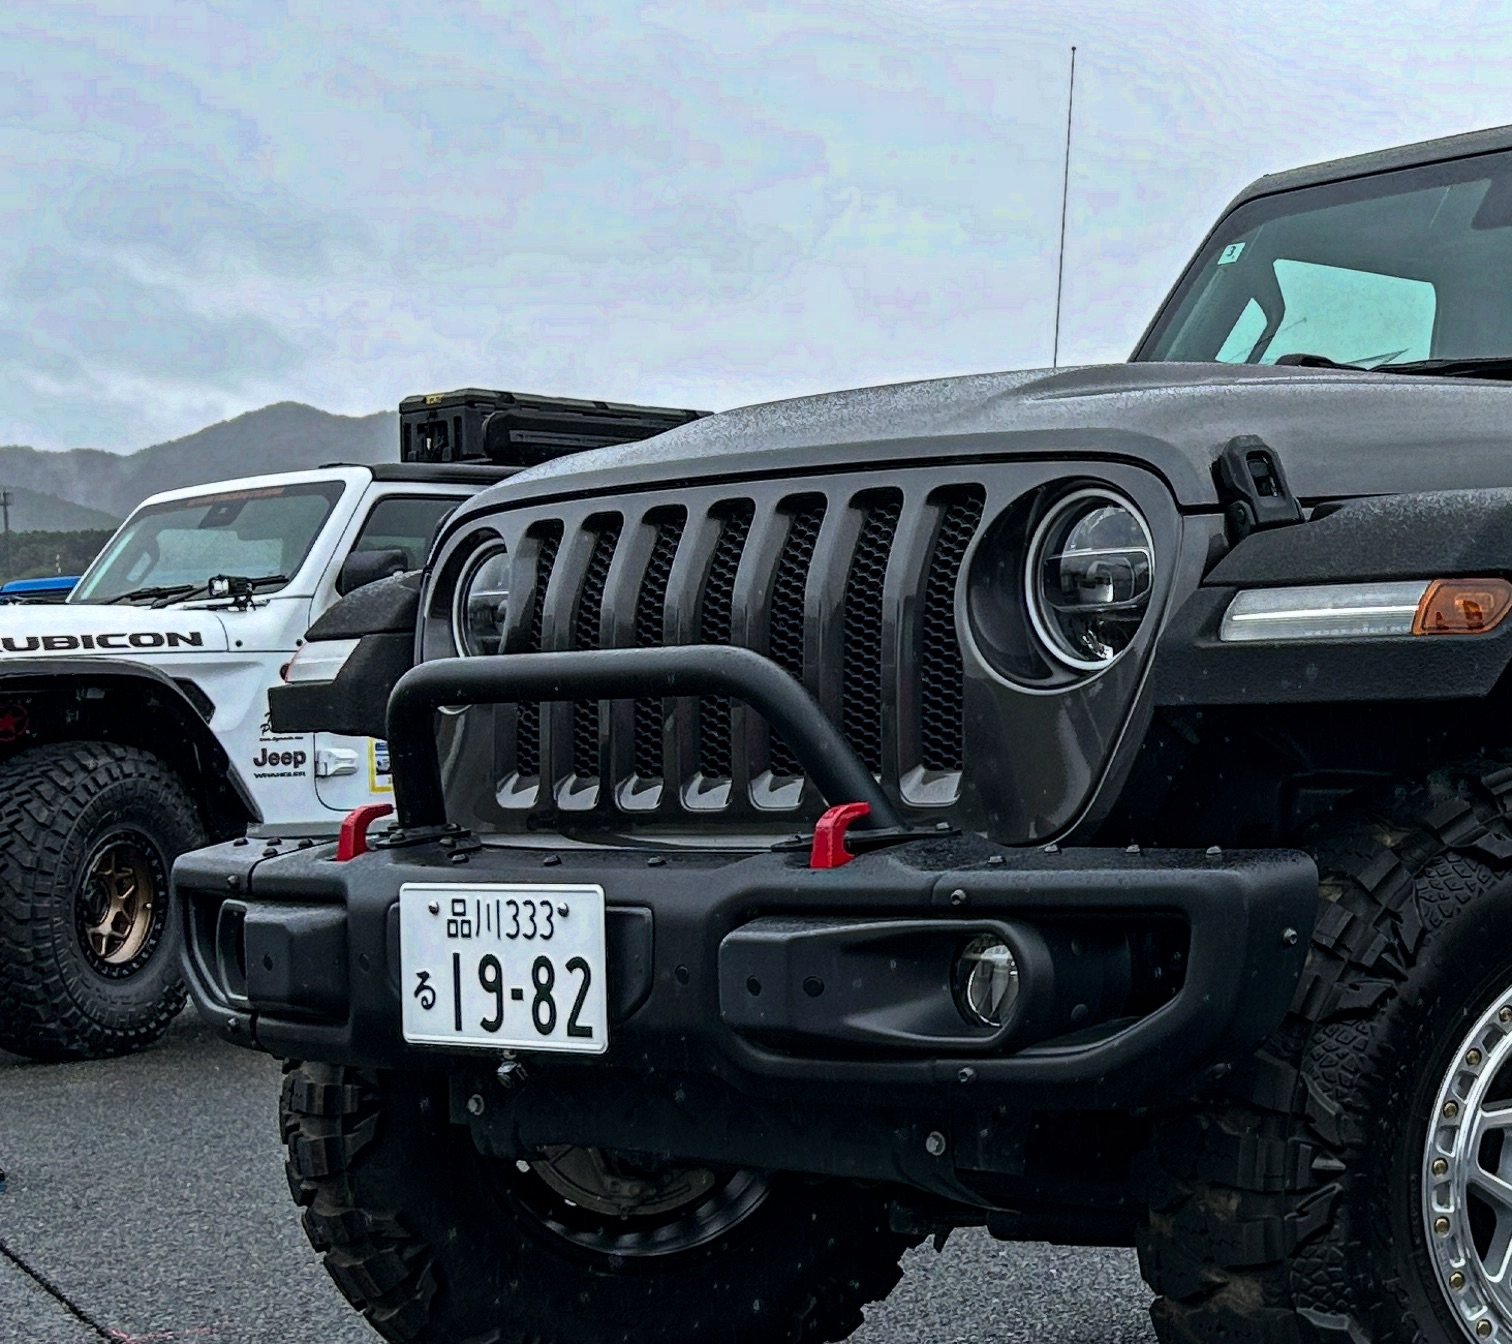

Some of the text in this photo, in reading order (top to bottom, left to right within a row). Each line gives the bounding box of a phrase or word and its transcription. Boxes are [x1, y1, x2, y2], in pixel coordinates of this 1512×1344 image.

[0, 631, 204, 653] UBICON
[253, 747, 307, 769] Jeep
[414, 952, 593, 1038] る 19-82
